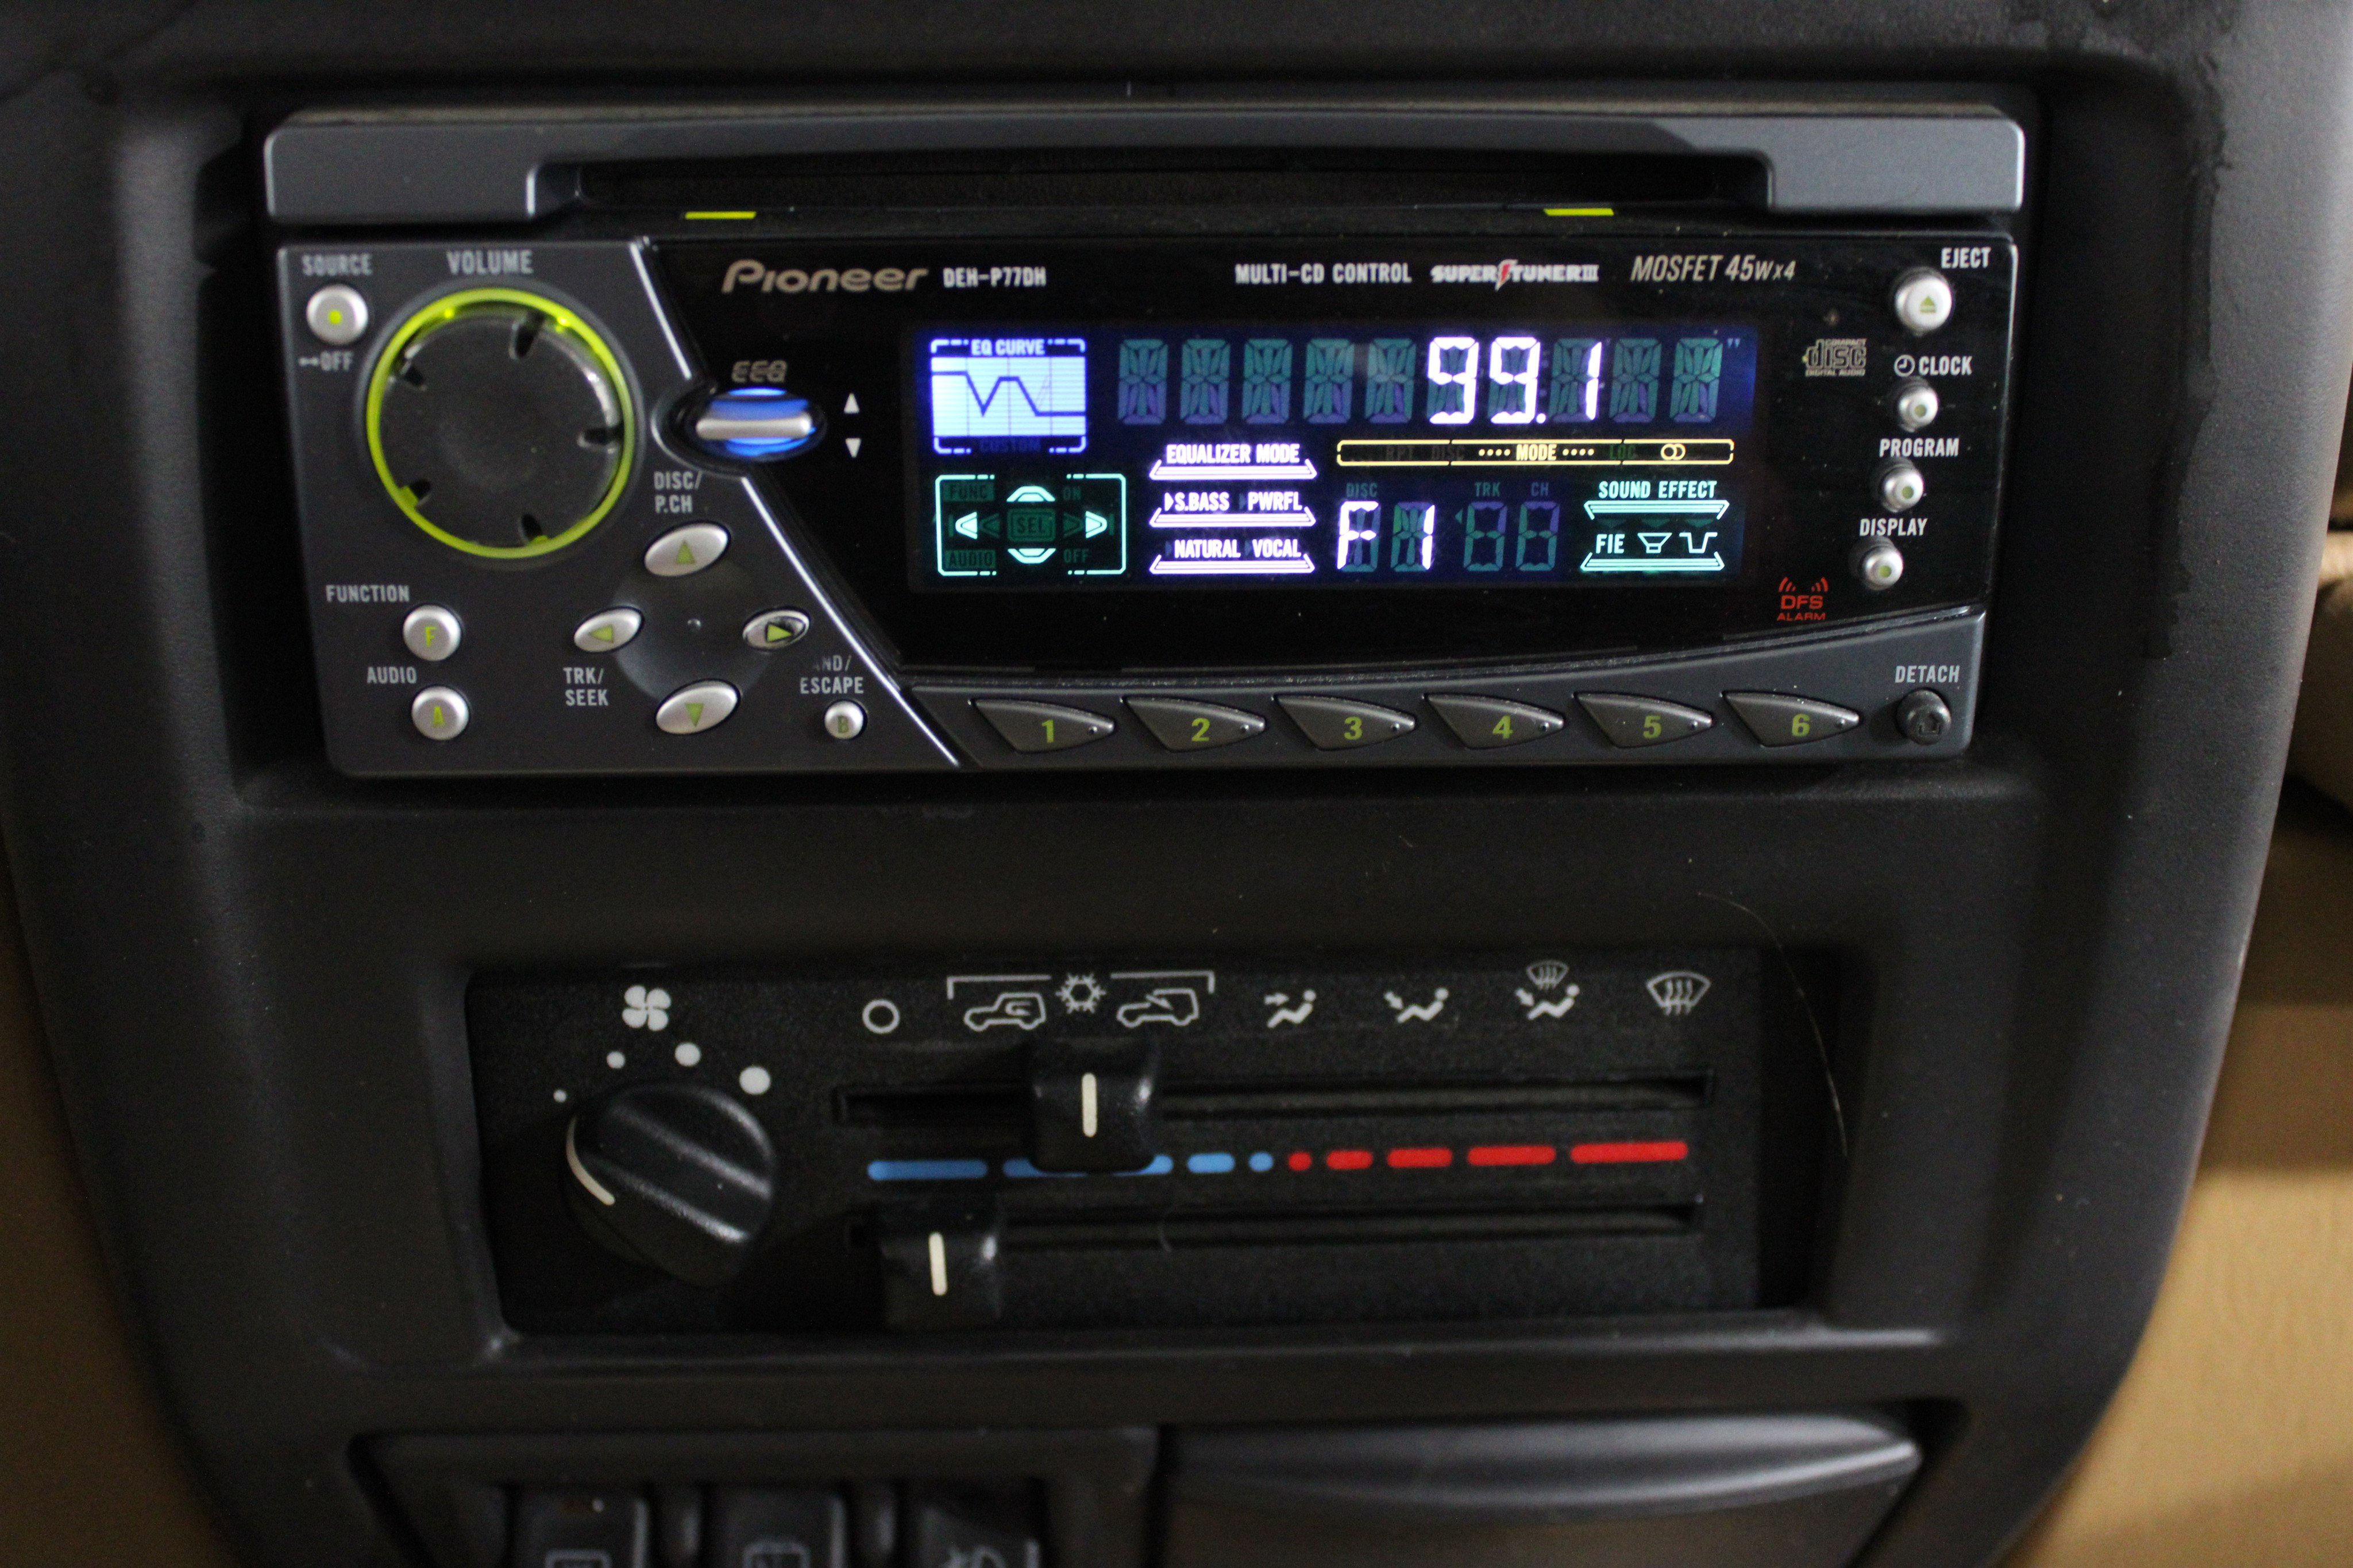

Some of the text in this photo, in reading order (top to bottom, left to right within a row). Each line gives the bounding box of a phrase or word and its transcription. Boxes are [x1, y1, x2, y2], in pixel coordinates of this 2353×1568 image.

[302, 253, 373, 276] SOURCE
[446, 250, 534, 275] VOLUME
[1941, 247, 1991, 269] EJECT
[722, 259, 929, 293] Pioneer
[1235, 262, 1413, 284] MULTI-CD CONTROL
[1430, 264, 1498, 283] SUPER
[1629, 254, 1724, 282] MOSFET
[971, 339, 1046, 356] EQ CURVE
[319, 351, 353, 372] OFF
[1918, 356, 1972, 376] CLOCK
[1428, 336, 1603, 425] 99.1
[1166, 443, 1300, 463] EQUALIZER MODE
[1515, 444, 1557, 461] MODE
[1879, 438, 1959, 458] PROGRAM
[653, 471, 702, 490] DISC/
[1345, 482, 1378, 498] DISC
[1474, 482, 1500, 497] TRK
[1530, 482, 1549, 497] CH
[1598, 480, 1718, 499] SOUND EFFECT
[948, 484, 989, 500] FUNC
[654, 495, 693, 513] P.CH
[1174, 492, 1302, 512] S.BASS PWRFL
[1860, 518, 1927, 537] DISPLAY
[1174, 539, 1302, 558] NATURAL VOCAL
[326, 585, 410, 603] FUNCTION
[1780, 595, 1823, 610] DFS
[1776, 612, 1826, 621] ALARM
[425, 626, 437, 647] F
[367, 666, 417, 684] AUDIO
[563, 667, 604, 685] TRK/
[1895, 665, 1960, 683] DETACH
[800, 676, 864, 694] ESCAPE
[565, 689, 609, 707] SEEK
[432, 705, 445, 728] A
[1791, 713, 1811, 737] 6
[1042, 720, 1054, 743] 1
[1191, 717, 1210, 741] 2
[1343, 716, 1363, 740] 3
[1492, 715, 1513, 739] 4
[1642, 715, 1662, 739] 5
